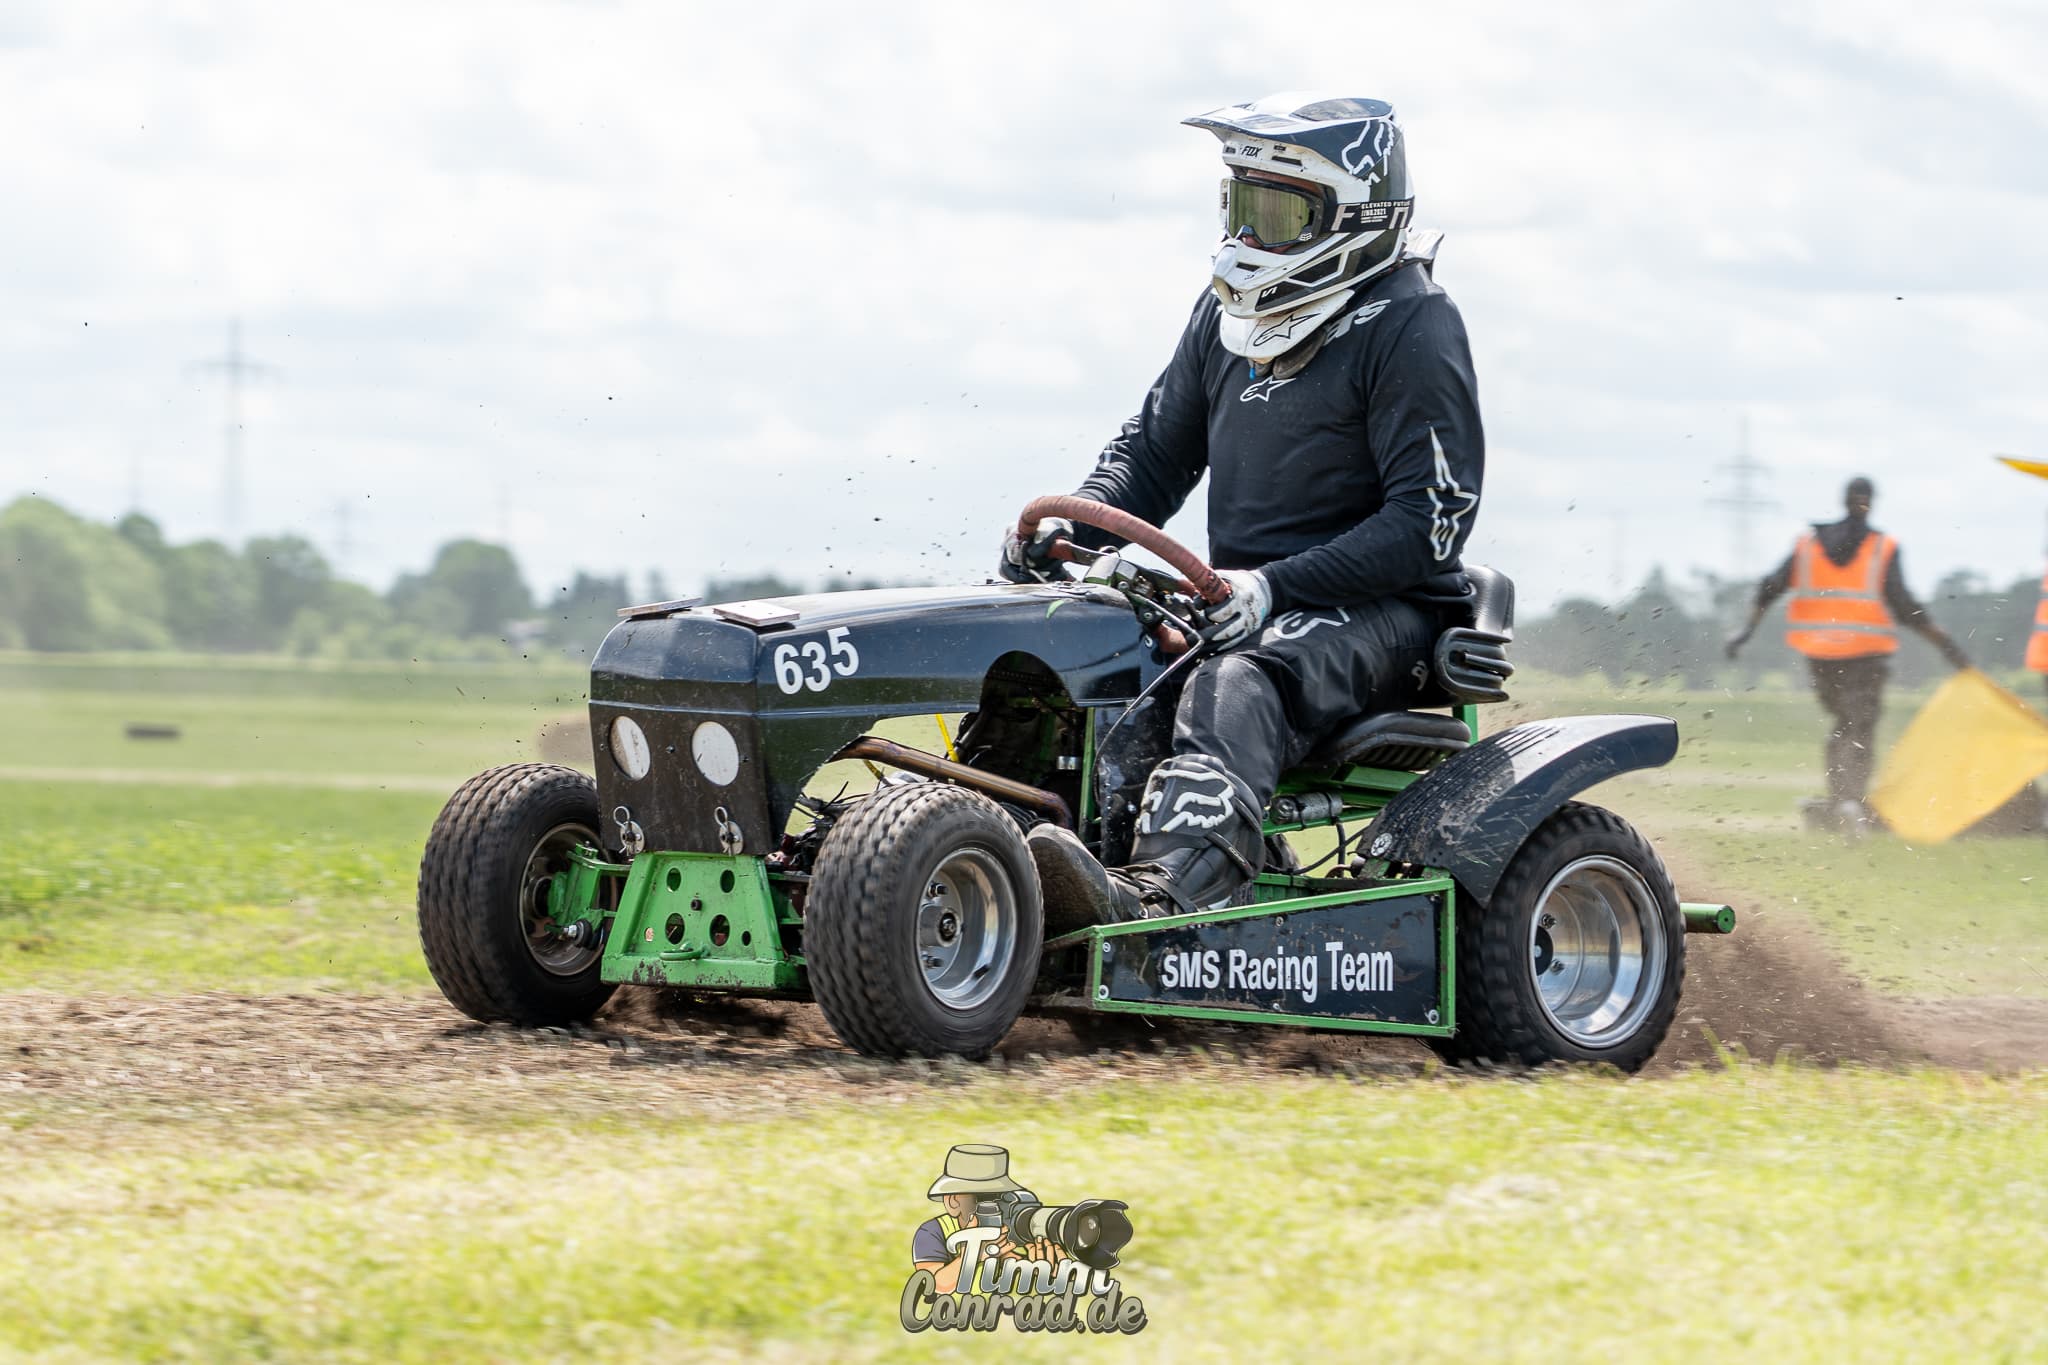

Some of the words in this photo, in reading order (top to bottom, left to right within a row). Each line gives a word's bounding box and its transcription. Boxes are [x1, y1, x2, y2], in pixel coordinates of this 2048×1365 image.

[1241, 145, 1263, 157] FOX
[774, 626, 859, 695] 635
[1161, 950, 1220, 989] SMS
[1228, 946, 1317, 1003] Racing
[1325, 941, 1394, 992] Team
